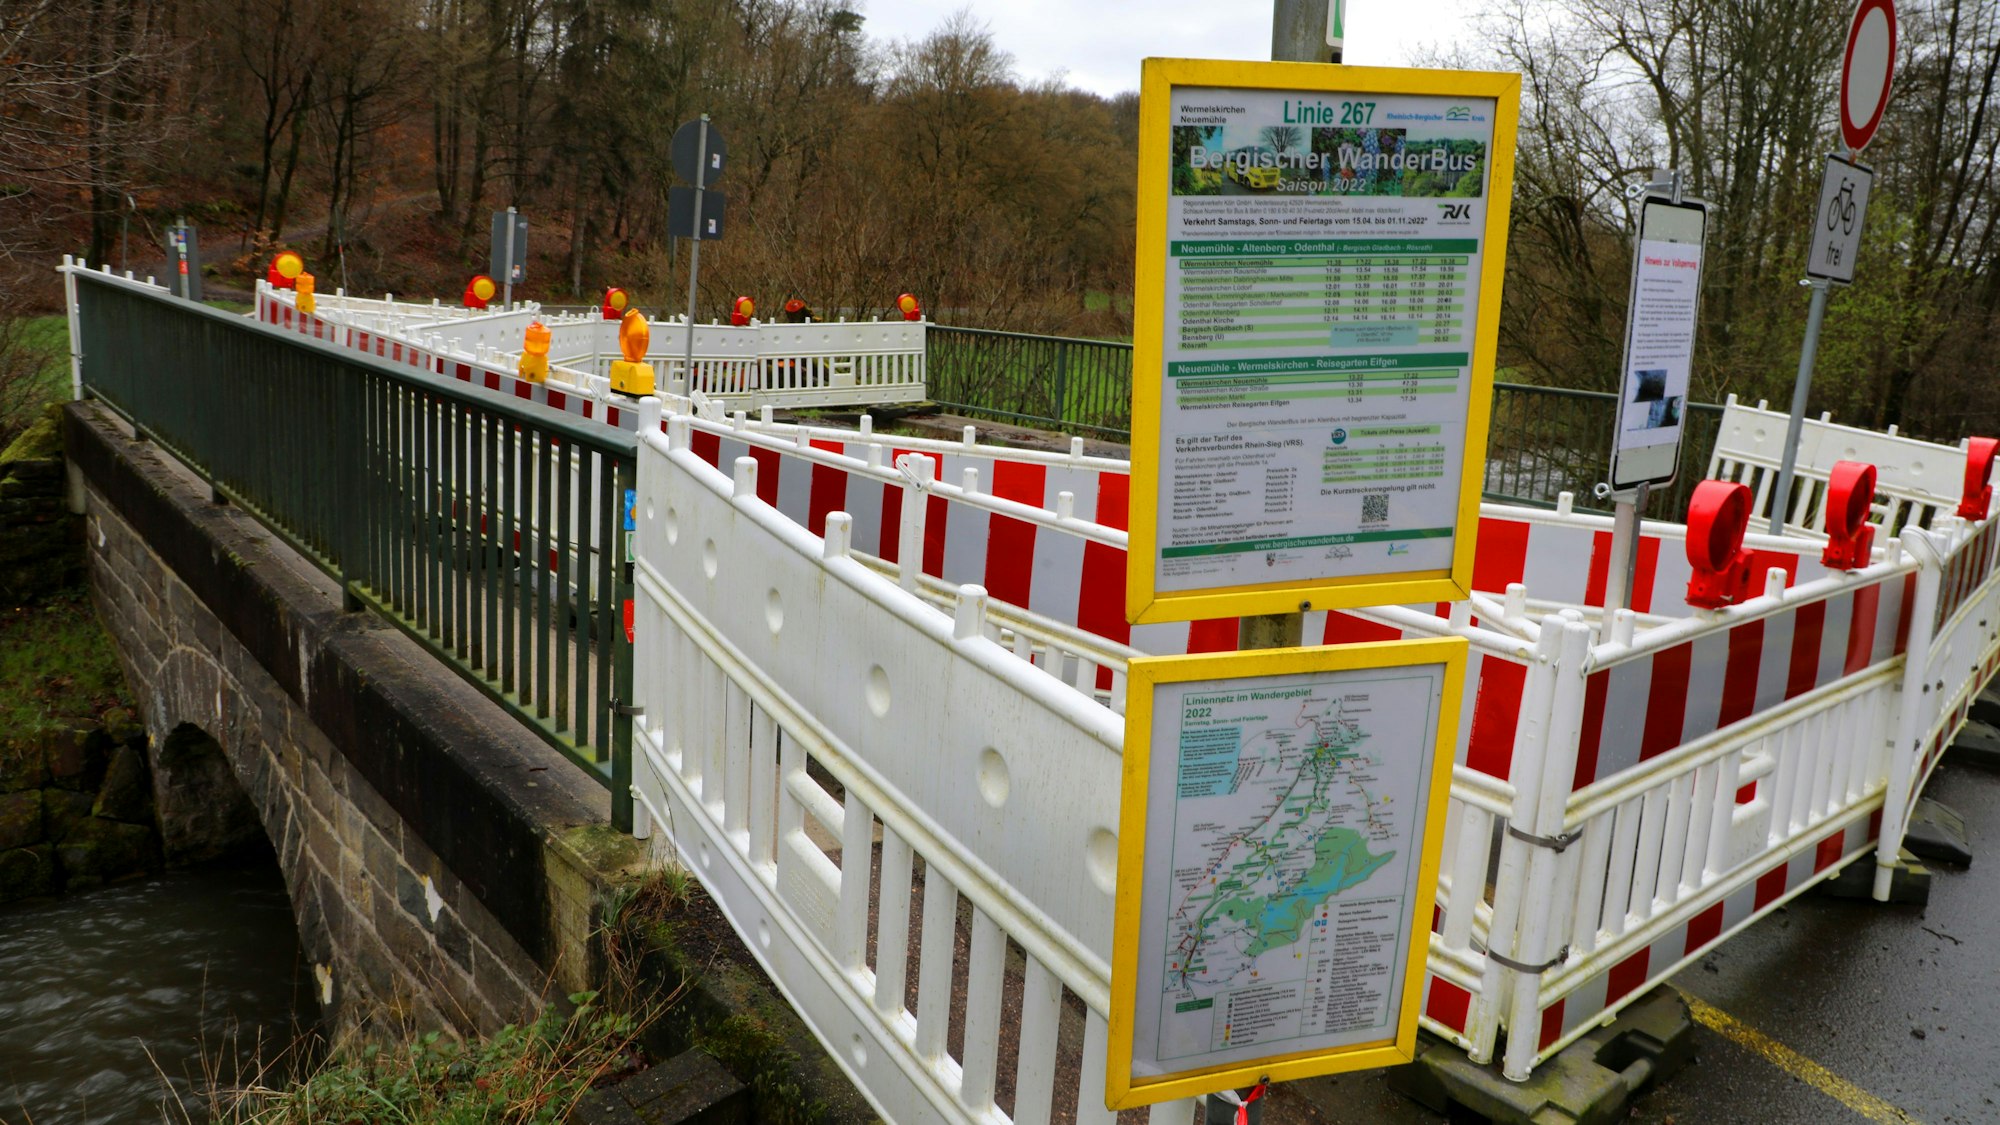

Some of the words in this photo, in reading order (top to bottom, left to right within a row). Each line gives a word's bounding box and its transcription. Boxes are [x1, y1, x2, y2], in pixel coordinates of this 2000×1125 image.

[1181, 105, 1245, 114] Wermelskirchen
[1284, 101, 1333, 124] Linie
[1341, 102, 1376, 124] 267
[1190, 146, 1330, 174] Bergischer
[1338, 147, 1476, 171] WanderBus
[1276, 178, 1327, 192] Saison
[1333, 179, 1366, 192] 2022
[1183, 218, 1215, 226] Verkehrt
[1218, 218, 1257, 227] Samstags,
[1283, 217, 1297, 225] und
[1299, 217, 1332, 226] Feiertags
[1181, 243, 1234, 253] Neuemühle
[1242, 243, 1286, 253] Altenberg
[1295, 243, 1335, 252] Odenthal
[1343, 244, 1370, 252] Bergisch
[1826, 241, 1844, 266] frei
[1178, 364, 1230, 373] Neuemühle
[1238, 361, 1308, 371] Wermelskirchen
[1316, 359, 1368, 369] Reisegarten
[1370, 358, 1397, 366] Eifgen
[1187, 437, 1198, 445] gilt
[1176, 444, 1243, 453] Verkehrsverbundes
[1406, 484, 1417, 492] gilt
[1254, 534, 1354, 550] www.bergischerwanderbus.de
[1186, 696, 1234, 706] Liniennetz
[1237, 694, 1248, 702] im
[1250, 688, 1312, 700] Wandergebiet
[1185, 708, 1212, 718] 2022
